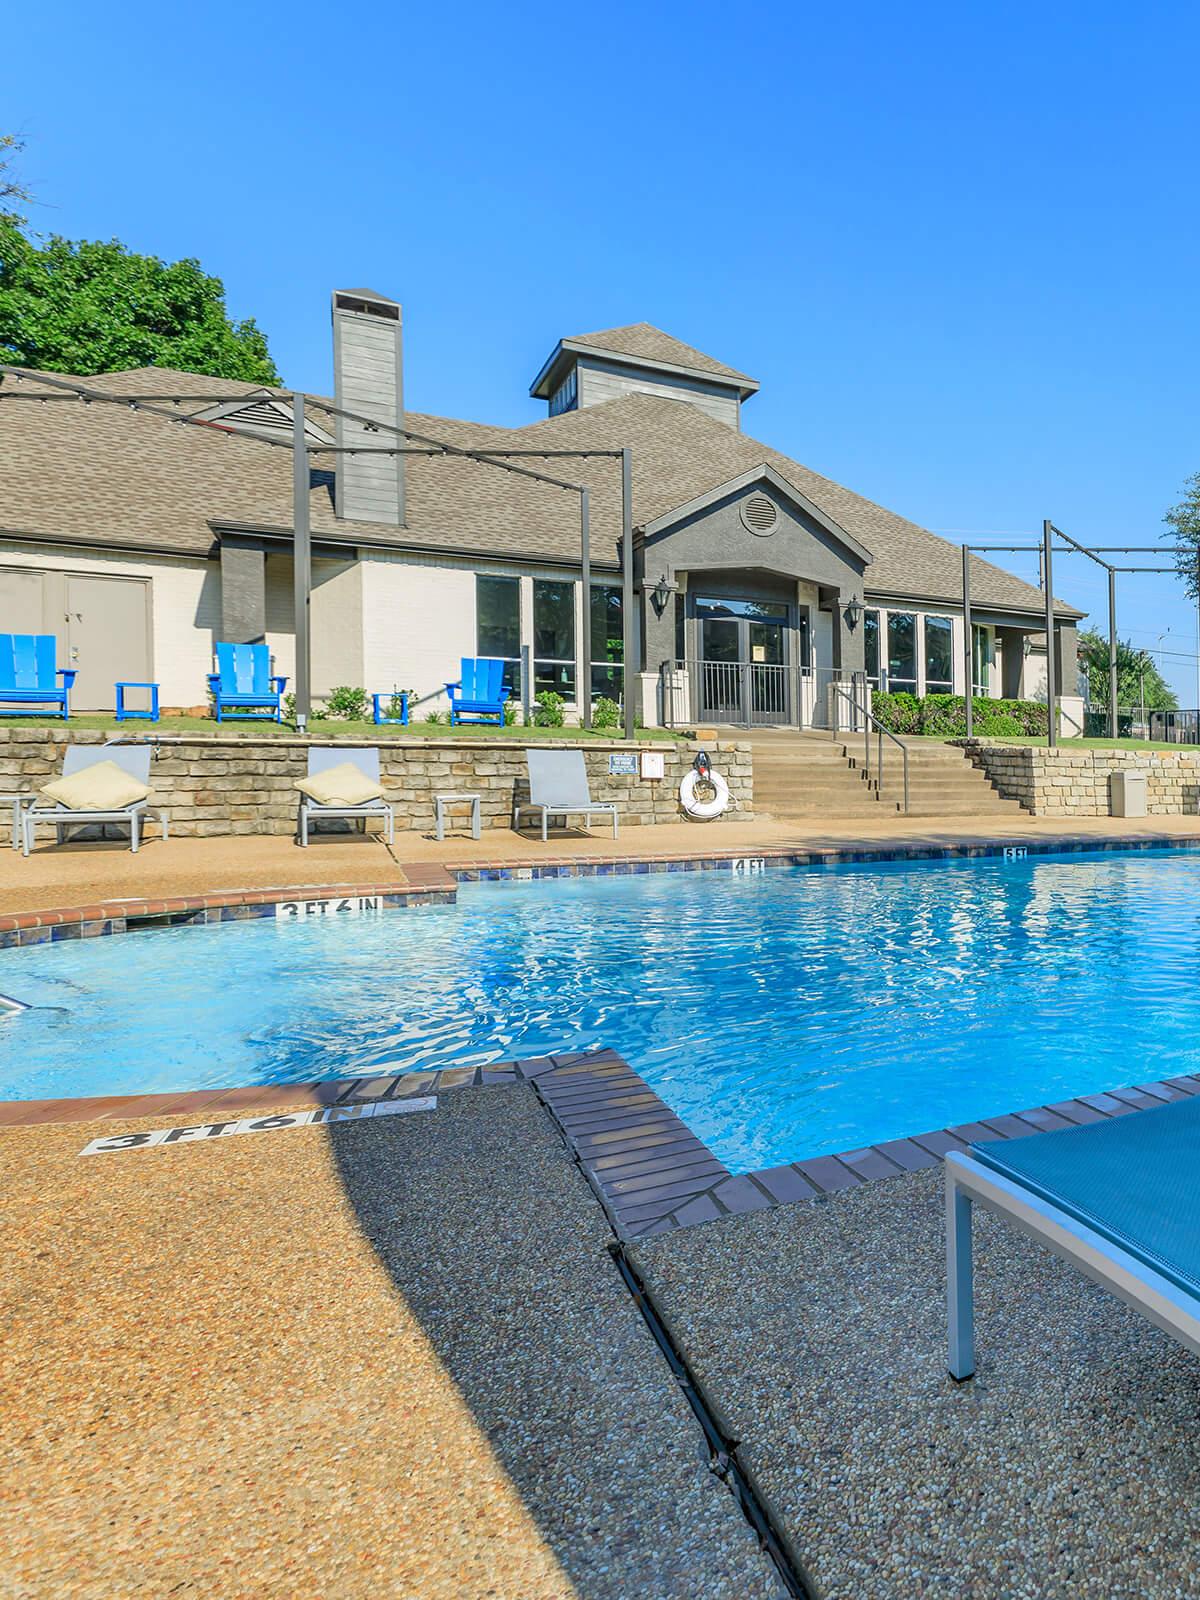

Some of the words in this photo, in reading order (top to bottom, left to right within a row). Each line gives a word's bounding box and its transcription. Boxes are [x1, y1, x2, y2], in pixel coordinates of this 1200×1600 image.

[735, 859, 744, 869] 4
[750, 859, 763, 869] FT
[305, 901, 329, 915] FT
[359, 897, 377, 910] IN
[95, 1133, 152, 1150] 3
[248, 1114, 297, 1129] 6
[311, 1105, 363, 1123] IN
